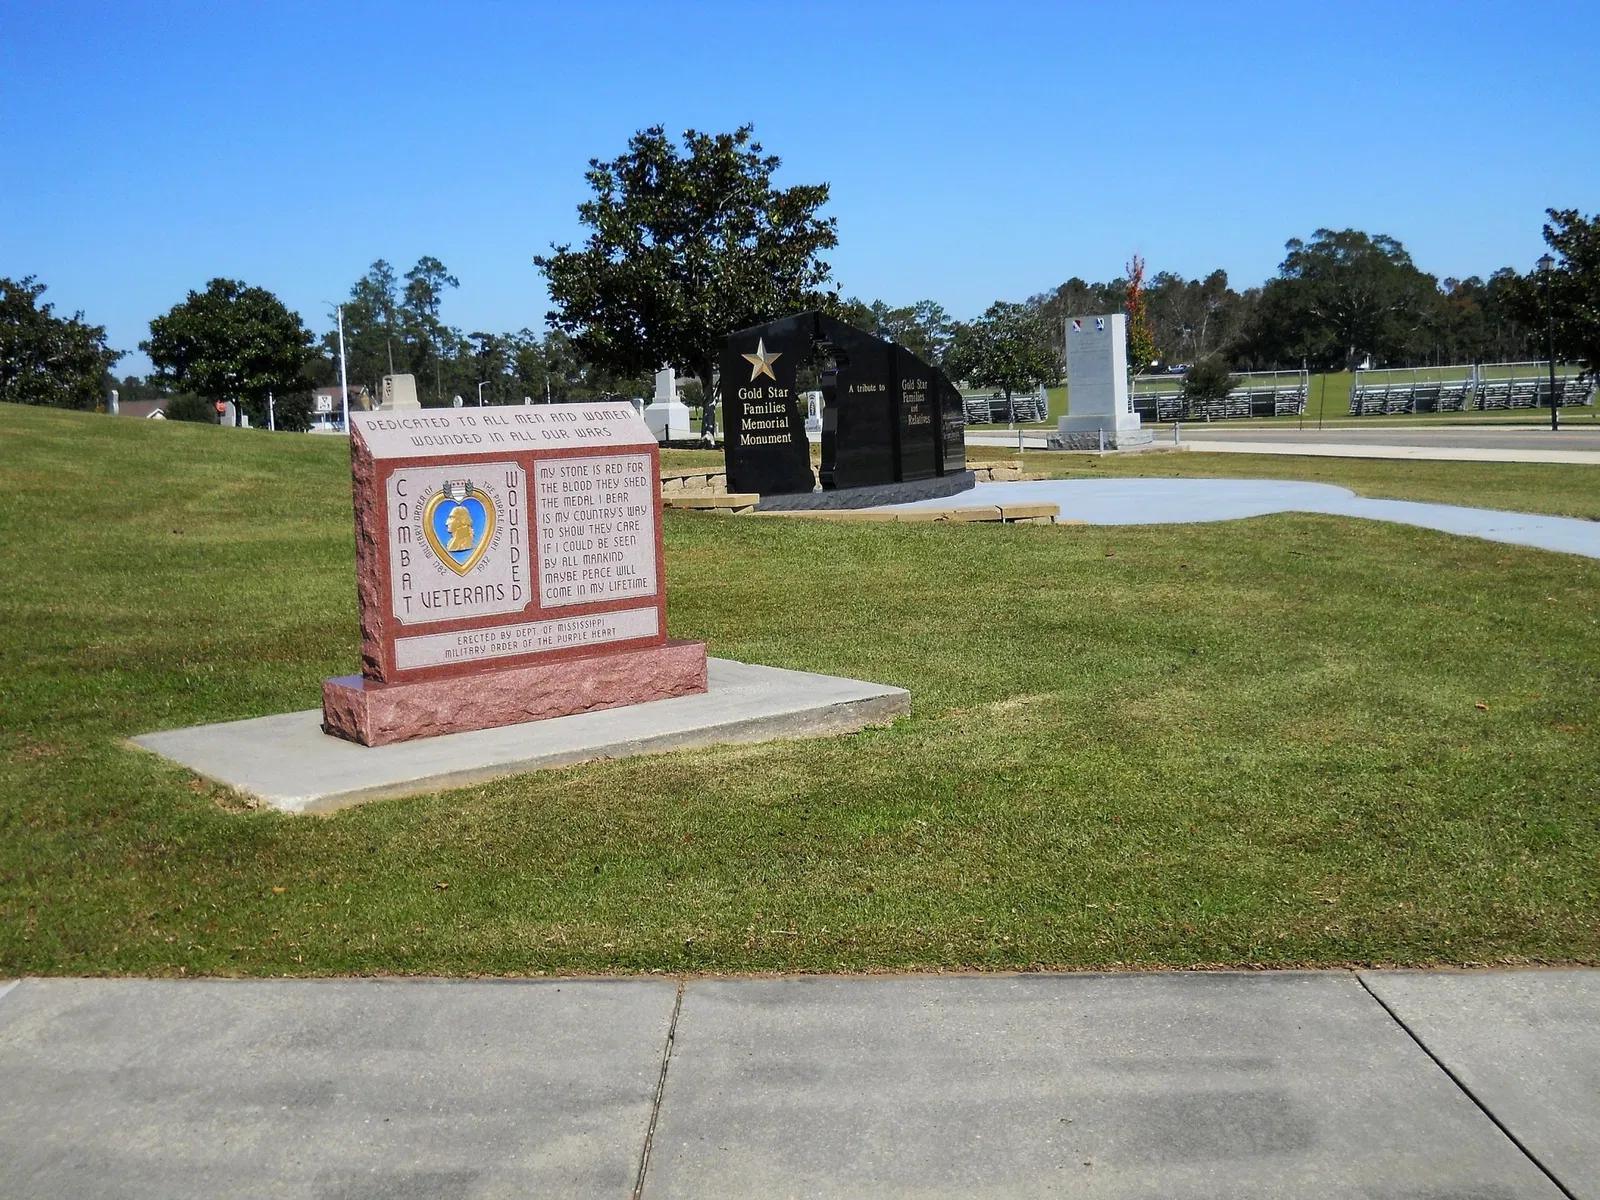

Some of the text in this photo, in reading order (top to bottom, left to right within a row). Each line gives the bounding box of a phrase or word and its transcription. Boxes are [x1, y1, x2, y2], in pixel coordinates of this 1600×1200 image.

[738, 386, 788, 400] Gold Star
[849, 384, 886, 393] A tribute to
[902, 379, 928, 390] Gold Star
[903, 392, 925, 403] Families
[743, 402, 786, 415] Families
[366, 409, 632, 431] DEDICATED TO ALL MEN AND WOMEN
[741, 416, 789, 430] Memorial
[411, 427, 612, 447] WOUNDED IN ALL OUR WARS
[740, 432, 792, 446] Monument
[541, 462, 644, 479] MY STONE IS RED FOR
[541, 476, 648, 494] THE BLOOD THEY SHED.
[542, 492, 629, 508] THE MEDAL I BEAR
[414, 485, 434, 559] MILITARY ORDER OF
[483, 481, 504, 551] THE PURPLE HEART
[542, 505, 647, 524] IS MY COUNTRY'S WAY
[506, 471, 522, 601] WOUNDED
[543, 528, 554, 538] TO
[559, 525, 584, 538] SHOW
[589, 523, 612, 534] THEY
[544, 535, 636, 554] IF I COULD BE SEEN
[433, 561, 447, 576] 1782
[477, 556, 491, 572] 1932
[544, 551, 624, 569] BY ALL MANKIND
[545, 565, 636, 584] MAYBE PEACE WILL
[421, 583, 505, 609] VETERANS
[546, 586, 572, 599] COME
[577, 584, 586, 595] IN
[590, 583, 604, 594] MY
[458, 632, 496, 646] ERECTED
[501, 631, 512, 639] BY
[543, 626, 552, 634] OF
[558, 619, 605, 632] MISSISSIPPI
[445, 628, 616, 658] MILITARY ORDER OF THE PURPLE HEART
